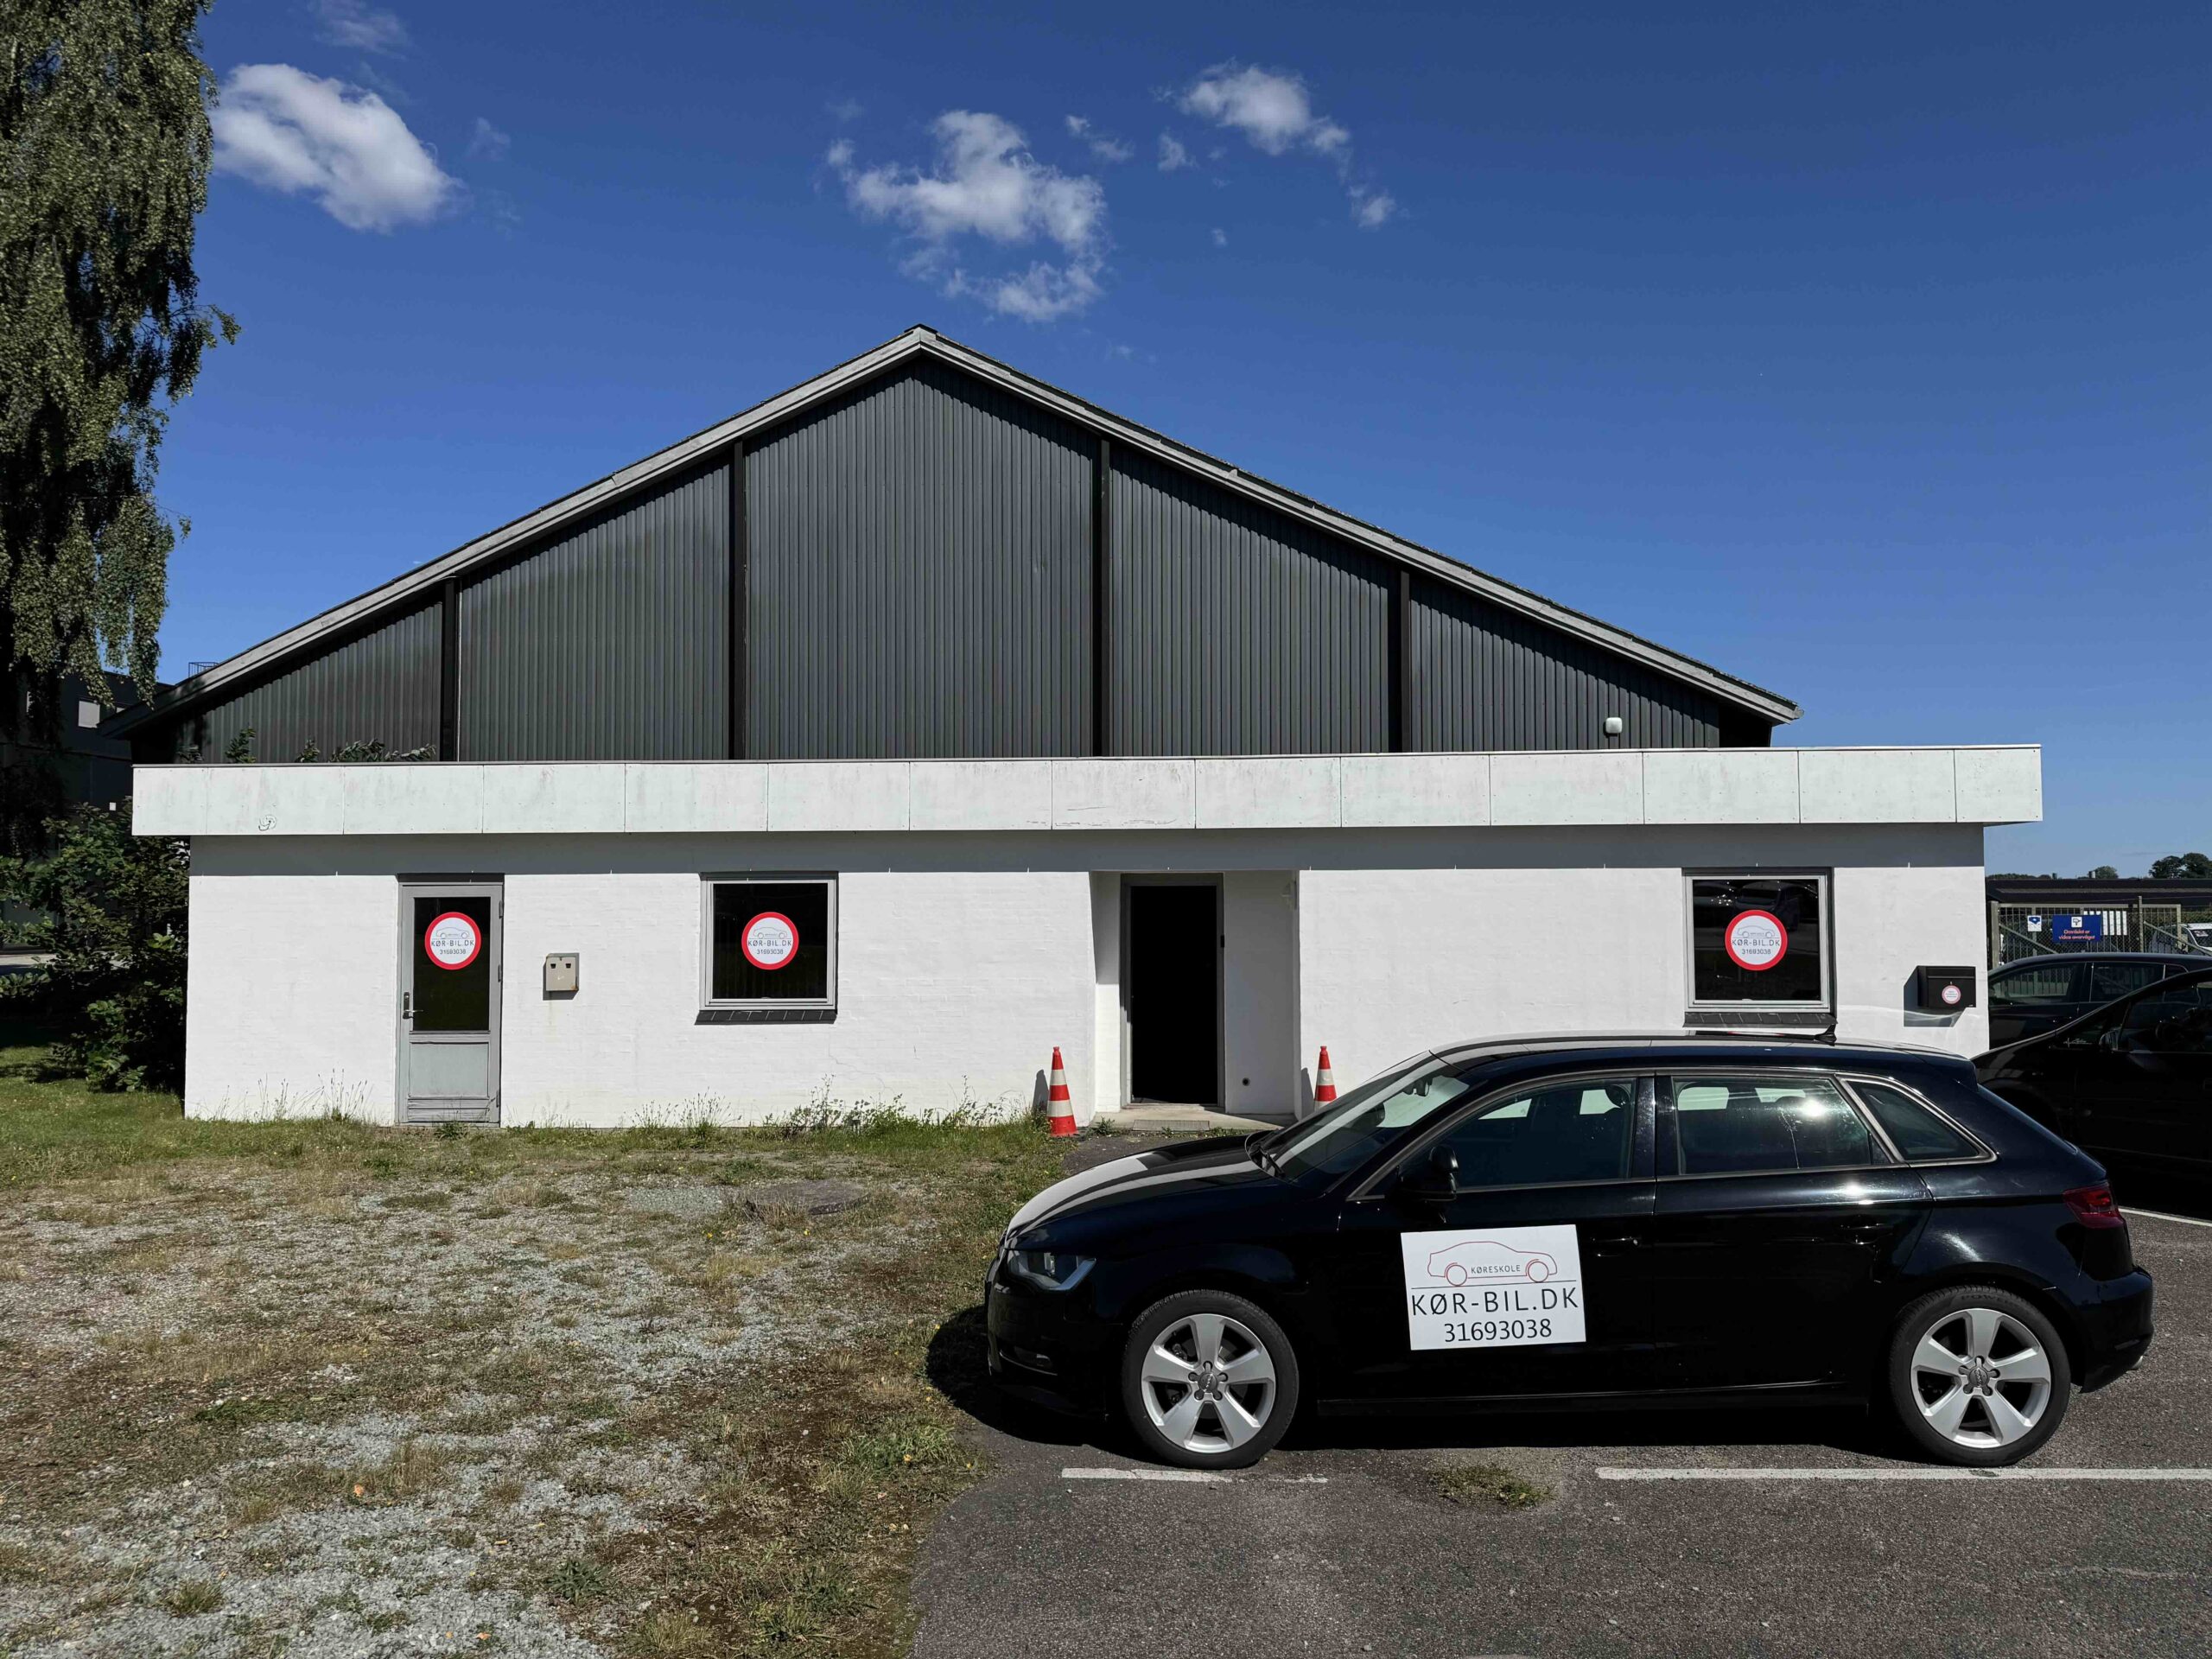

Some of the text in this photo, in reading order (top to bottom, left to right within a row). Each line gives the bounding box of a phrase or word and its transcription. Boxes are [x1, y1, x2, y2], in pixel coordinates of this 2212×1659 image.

[1471, 1264, 1521, 1274] KØRESKOLE
[1411, 1287, 1579, 1316] KØR-BIL.DK
[1444, 1319, 1552, 1343] 31693038
